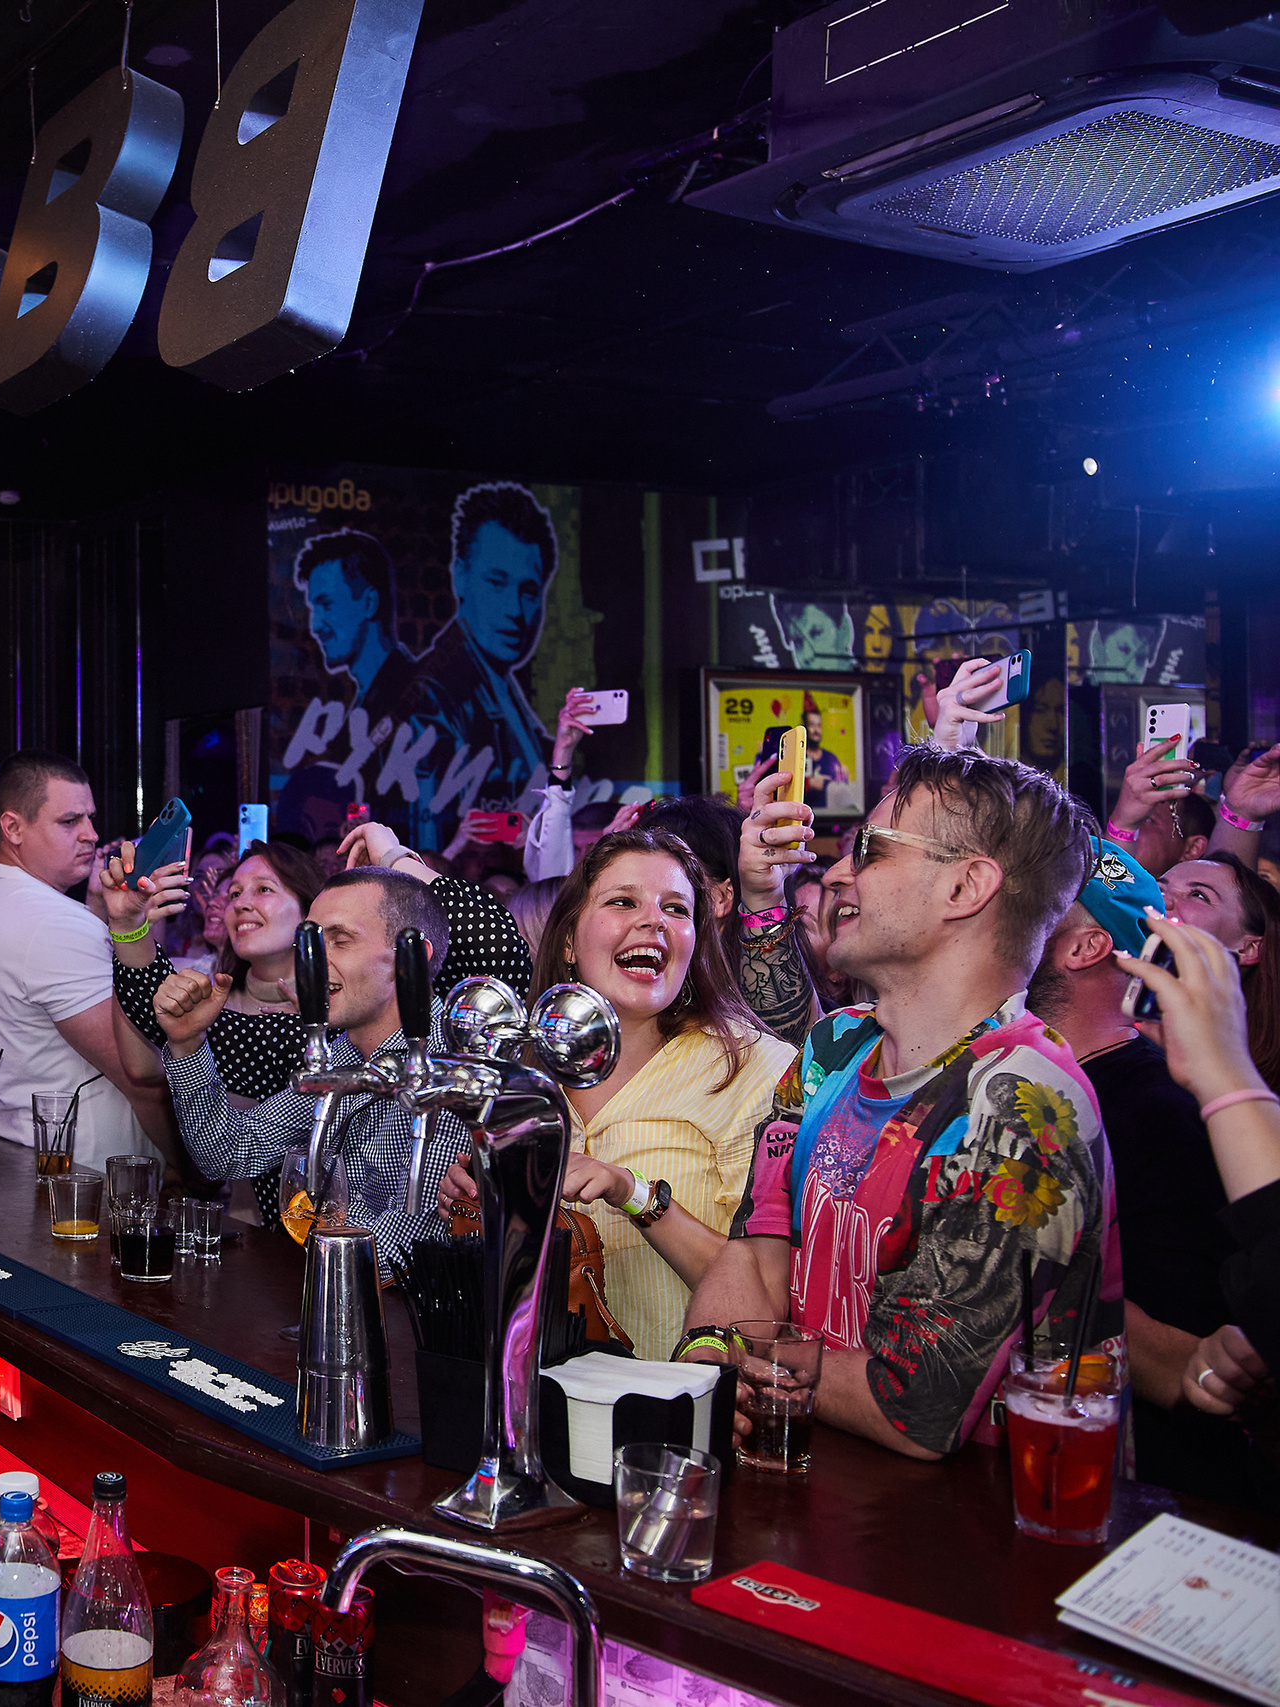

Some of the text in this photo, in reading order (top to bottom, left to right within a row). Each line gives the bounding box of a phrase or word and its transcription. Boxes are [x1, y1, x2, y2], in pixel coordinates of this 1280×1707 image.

[725, 698, 754, 716] 29
[20, 1612, 39, 1667] pepsi
[315, 1650, 366, 1675] EVERVESS
